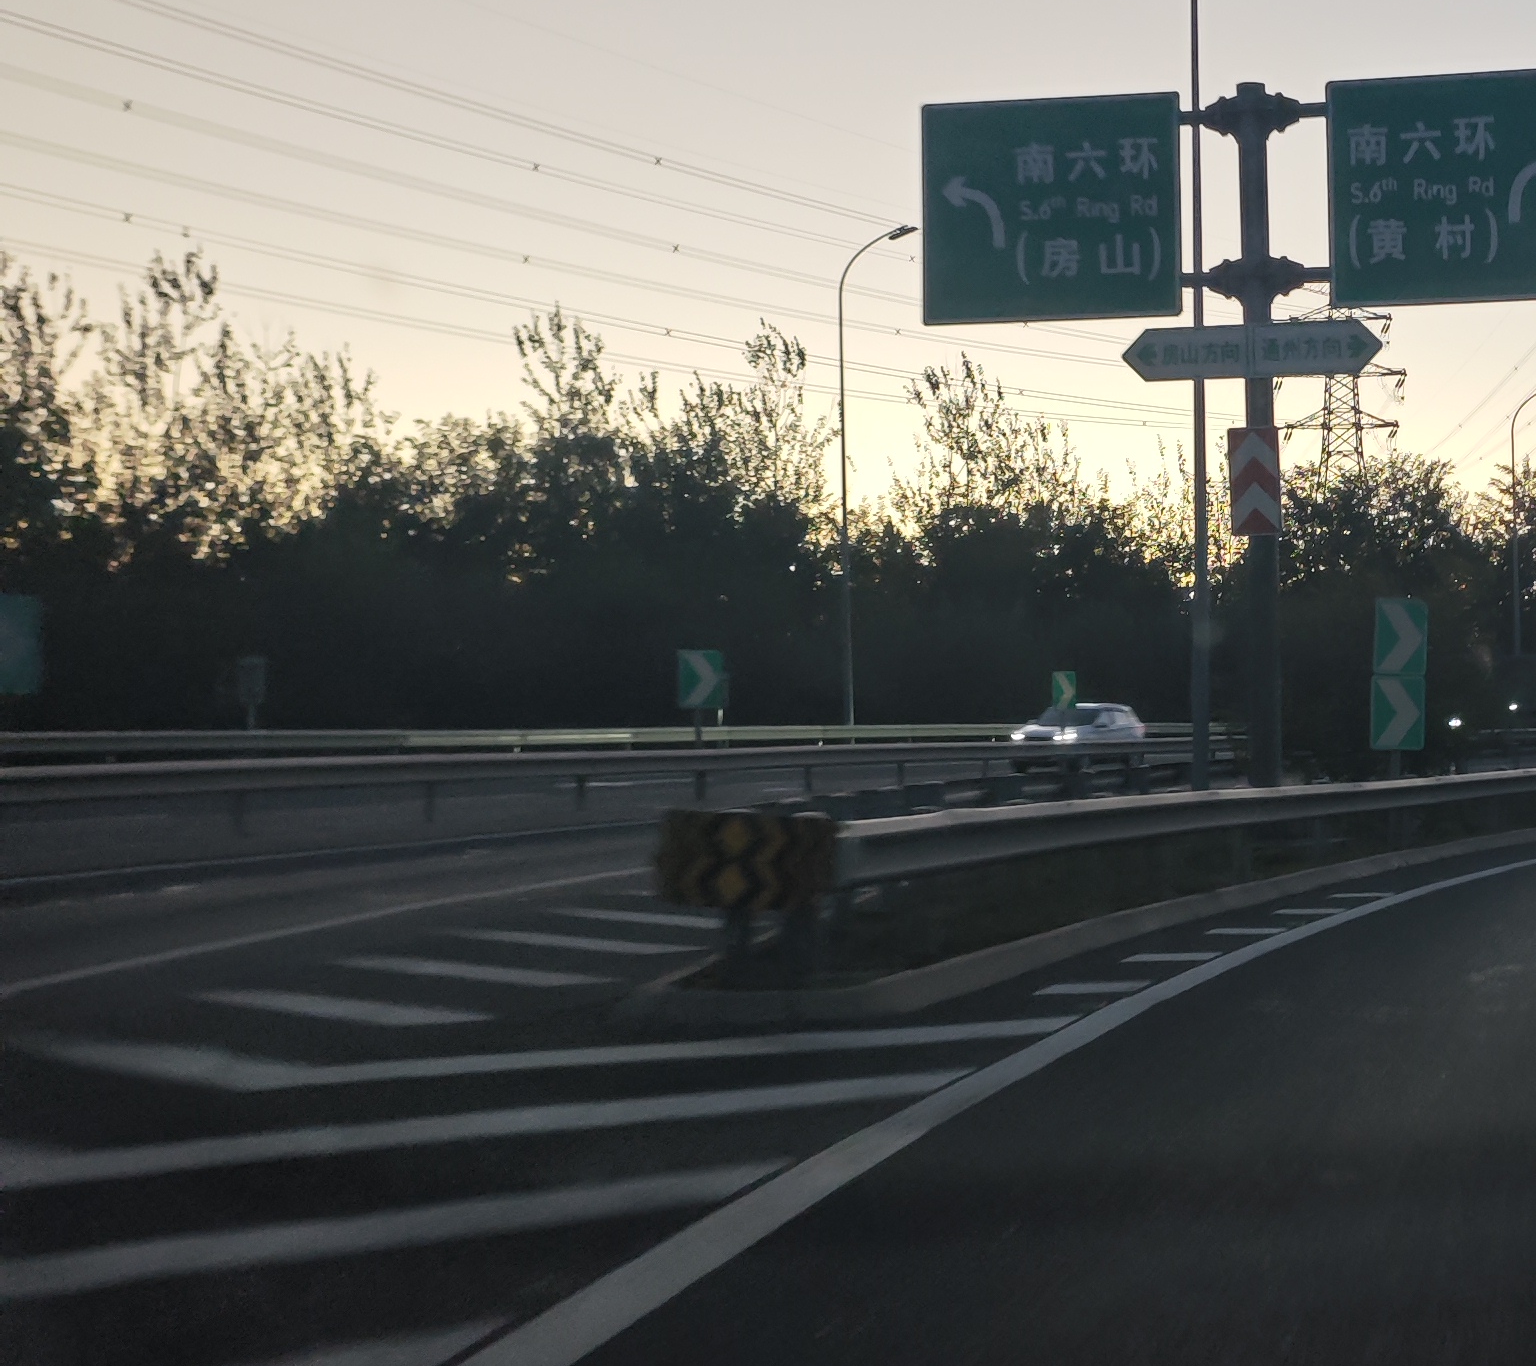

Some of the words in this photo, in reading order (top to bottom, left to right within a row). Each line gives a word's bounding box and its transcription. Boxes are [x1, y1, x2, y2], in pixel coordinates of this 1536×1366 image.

[1347, 115, 1496, 166] 南六环
[1014, 138, 1159, 183] 南六环
[1413, 178, 1457, 205] Ring
[1468, 176, 1494, 197] Rd
[1076, 197, 1120, 223] Ring
[1130, 195, 1158, 216] Rd
[1162, 341, 1240, 366] 房山方向
[1262, 337, 1342, 362] 通州方向
